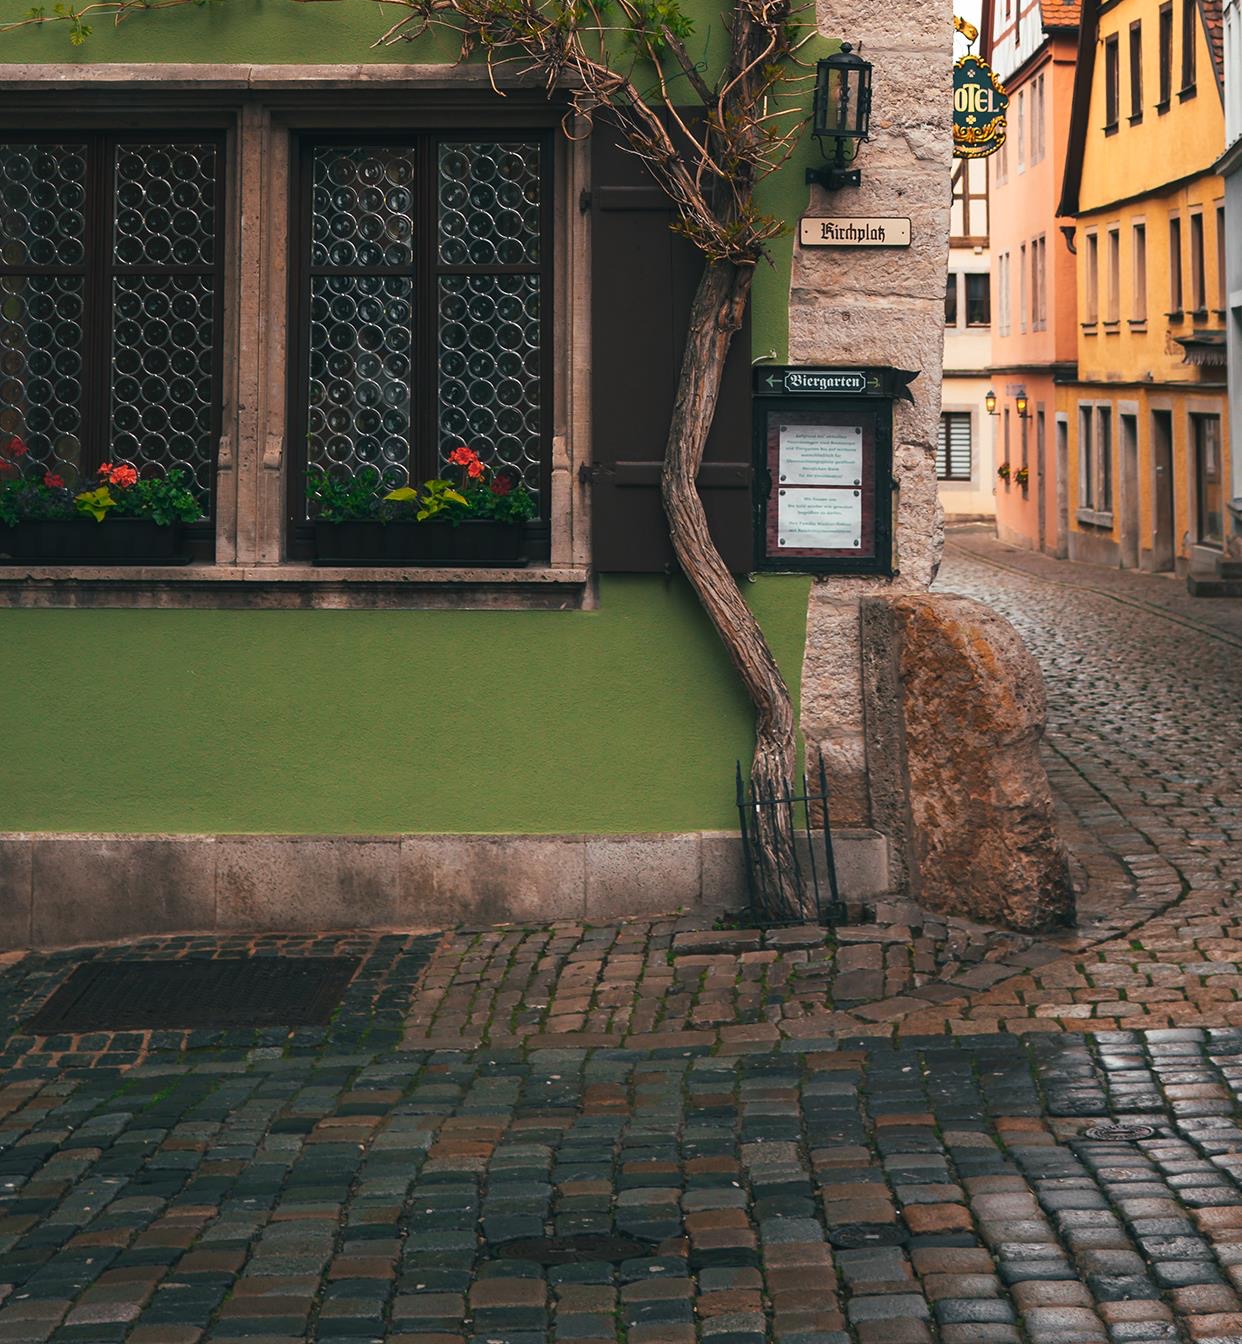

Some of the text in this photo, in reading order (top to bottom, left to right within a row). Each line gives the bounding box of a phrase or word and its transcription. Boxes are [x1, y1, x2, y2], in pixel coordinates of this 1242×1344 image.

[953, 83, 999, 112] OTEL
[820, 222, 886, 243] Kirchplatz
[790, 373, 860, 390] Biergarten
